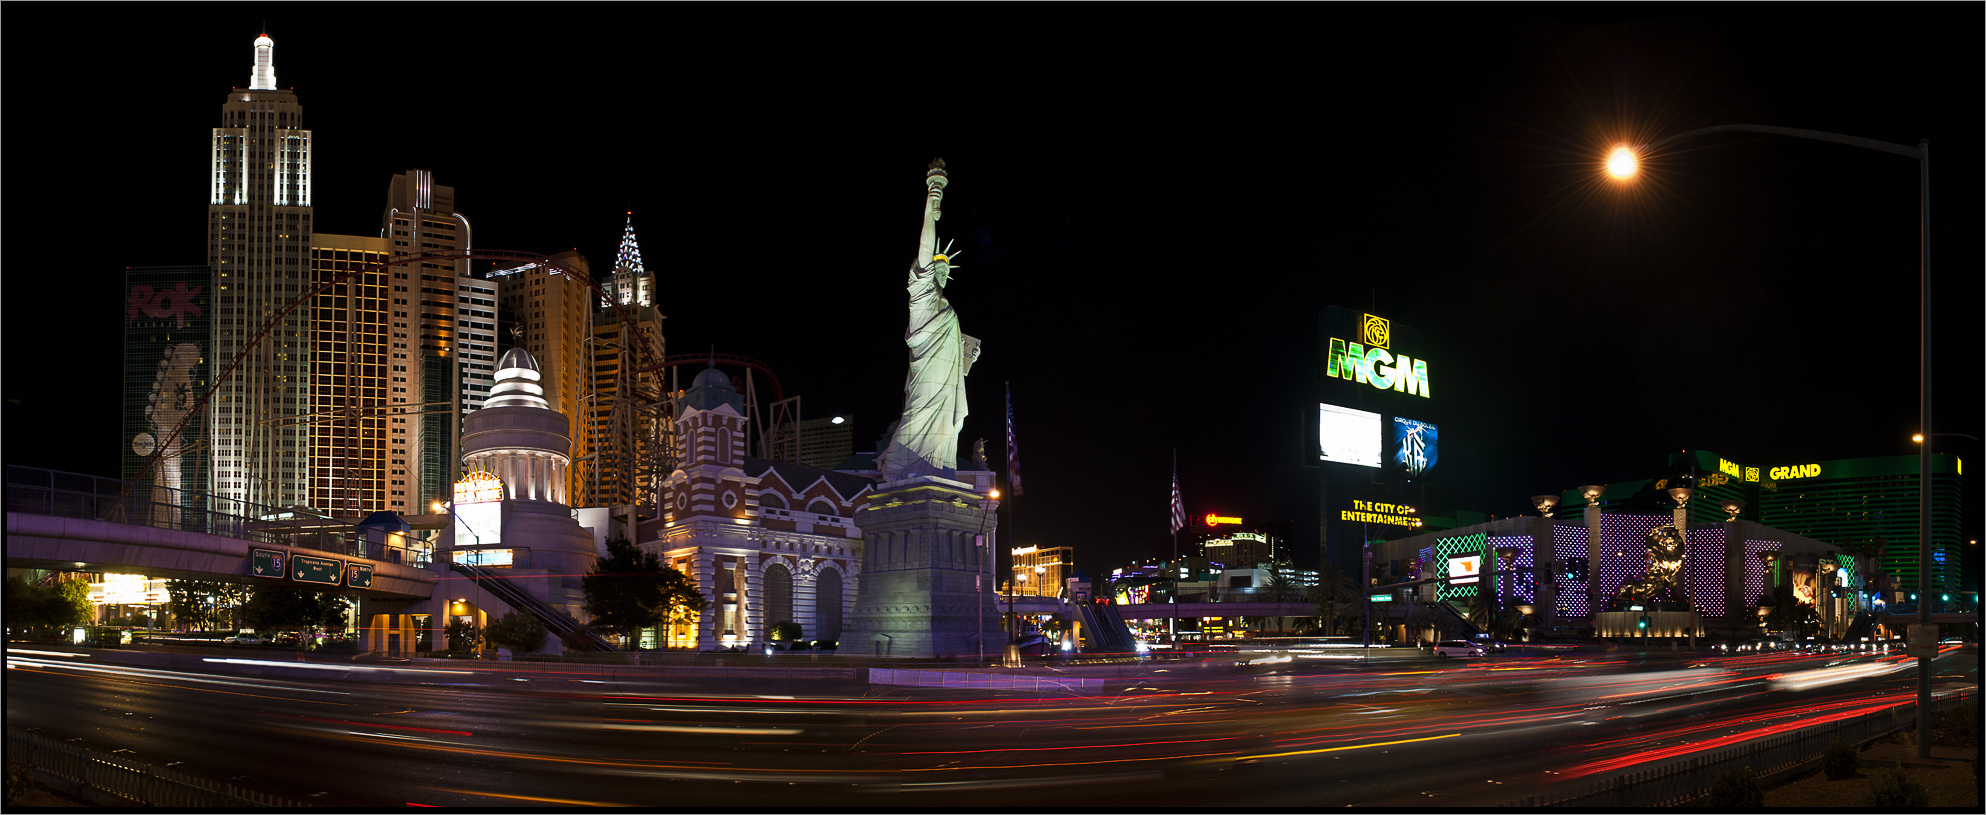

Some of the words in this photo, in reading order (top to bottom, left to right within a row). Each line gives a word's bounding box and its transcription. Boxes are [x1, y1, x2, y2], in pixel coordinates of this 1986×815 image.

[1327, 337, 1430, 399] MGM
[1719, 457, 1740, 479] MGM
[1769, 463, 1822, 481] GRAND
[1353, 499, 1373, 512] THE
[1374, 502, 1395, 514] CITY
[1396, 505, 1410, 515] OF
[272, 558, 282, 568] 15
[301, 558, 320, 566] Tropicana
[350, 570, 359, 578] 15
